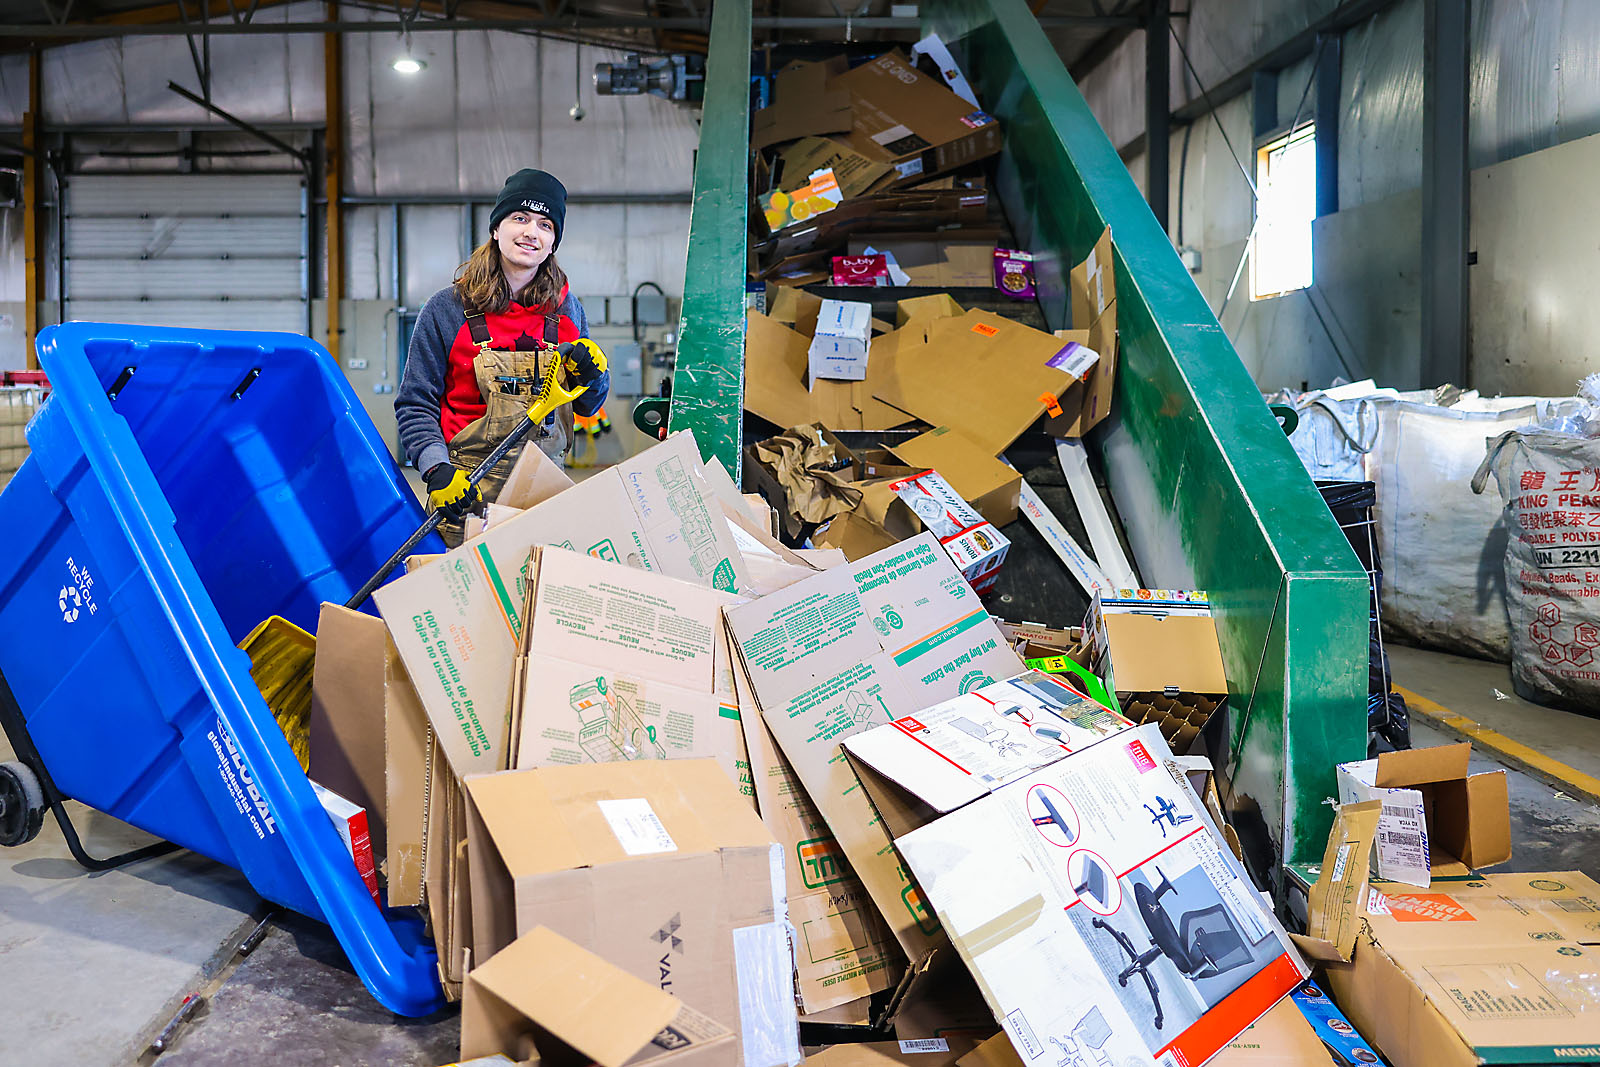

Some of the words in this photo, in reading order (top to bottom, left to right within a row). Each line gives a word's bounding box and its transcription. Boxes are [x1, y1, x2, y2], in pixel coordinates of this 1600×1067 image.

[842, 256, 875, 266] bubly
[1518, 494, 1548, 509] KING
[904, 549, 914, 559] no
[912, 540, 931, 557] Cajas
[959, 538, 978, 559] BONUS
[870, 552, 907, 576] usadas-Con
[919, 552, 938, 567] 100%
[1536, 551, 1553, 565] UN
[1562, 550, 1600, 564] 2211
[80, 565, 95, 590] WE
[852, 567, 873, 584] Recib
[887, 570, 897, 582] de
[1549, 572, 1580, 584] Beads,
[66, 557, 99, 616] RECYCLE
[422, 608, 443, 639] 100%
[555, 617, 586, 631] RECYCLE
[618, 633, 640, 644] REUSE
[928, 626, 959, 646] uhaul.com
[1012, 631, 1053, 641] TOMATOES
[670, 646, 695, 658] REDUCE
[966, 644, 983, 660] Buy
[979, 637, 997, 653] We'll
[941, 660, 956, 675] the
[952, 652, 972, 669] Back
[919, 667, 945, 687] Extras.
[409, 613, 432, 644] Cajas
[424, 644, 438, 660] no
[431, 659, 467, 721] usadas-Con
[459, 720, 484, 758] Recibo
[456, 682, 470, 698] de
[460, 698, 494, 752] Recompra
[734, 759, 748, 770] ack
[203, 728, 268, 840] globalindustrial.com
[738, 772, 752, 783] TY!
[738, 784, 754, 796] ES?
[1213, 854, 1230, 878] CHAIR
[659, 953, 675, 995] VAL
[821, 977, 836, 987] USES!
[836, 970, 857, 982] MULTIPLE
